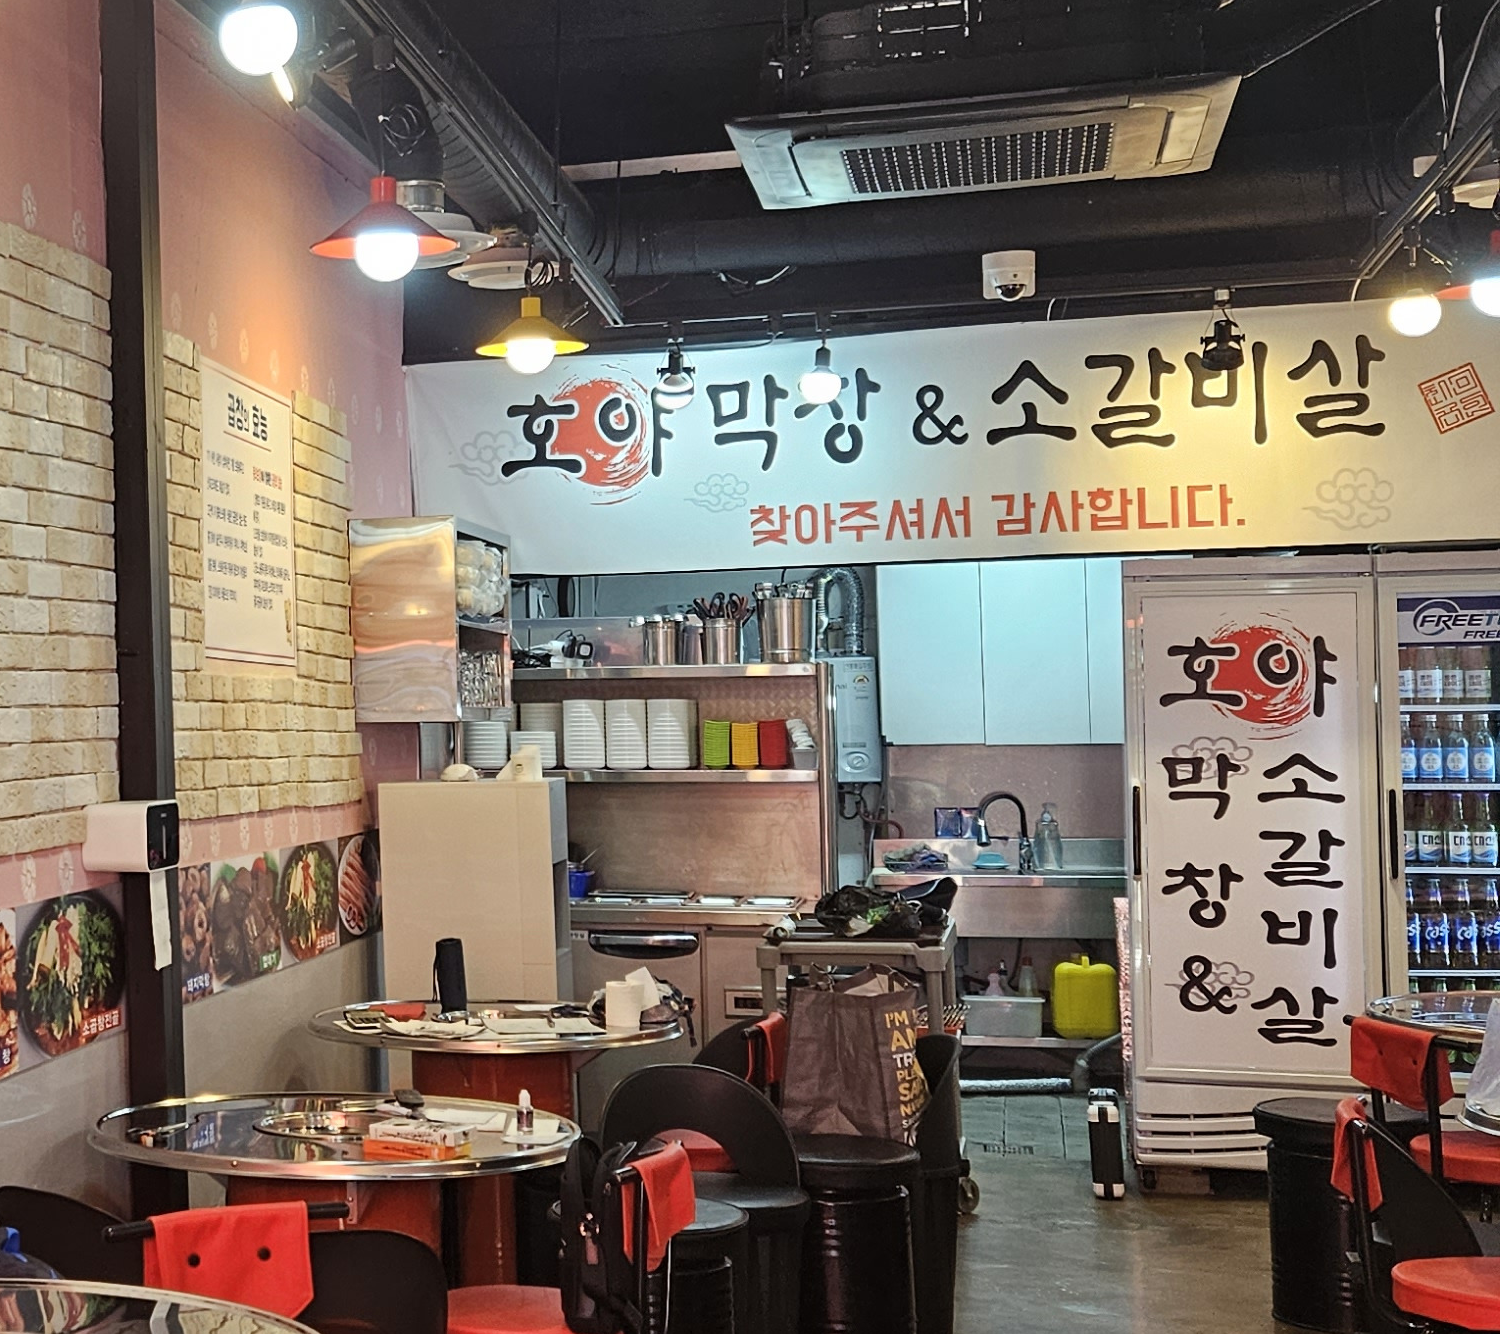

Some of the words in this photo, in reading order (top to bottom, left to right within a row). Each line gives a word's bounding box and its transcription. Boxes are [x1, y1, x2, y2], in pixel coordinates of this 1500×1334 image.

[500, 385, 676, 478] 호야
[911, 383, 969, 448] &
[985, 333, 1387, 454] 소갈비살
[748, 500, 974, 548] 찾아주셔서
[990, 482, 1248, 537] 감사합니다.
[1418, 612, 1500, 631] FREET
[1159, 634, 1340, 720] 호야
